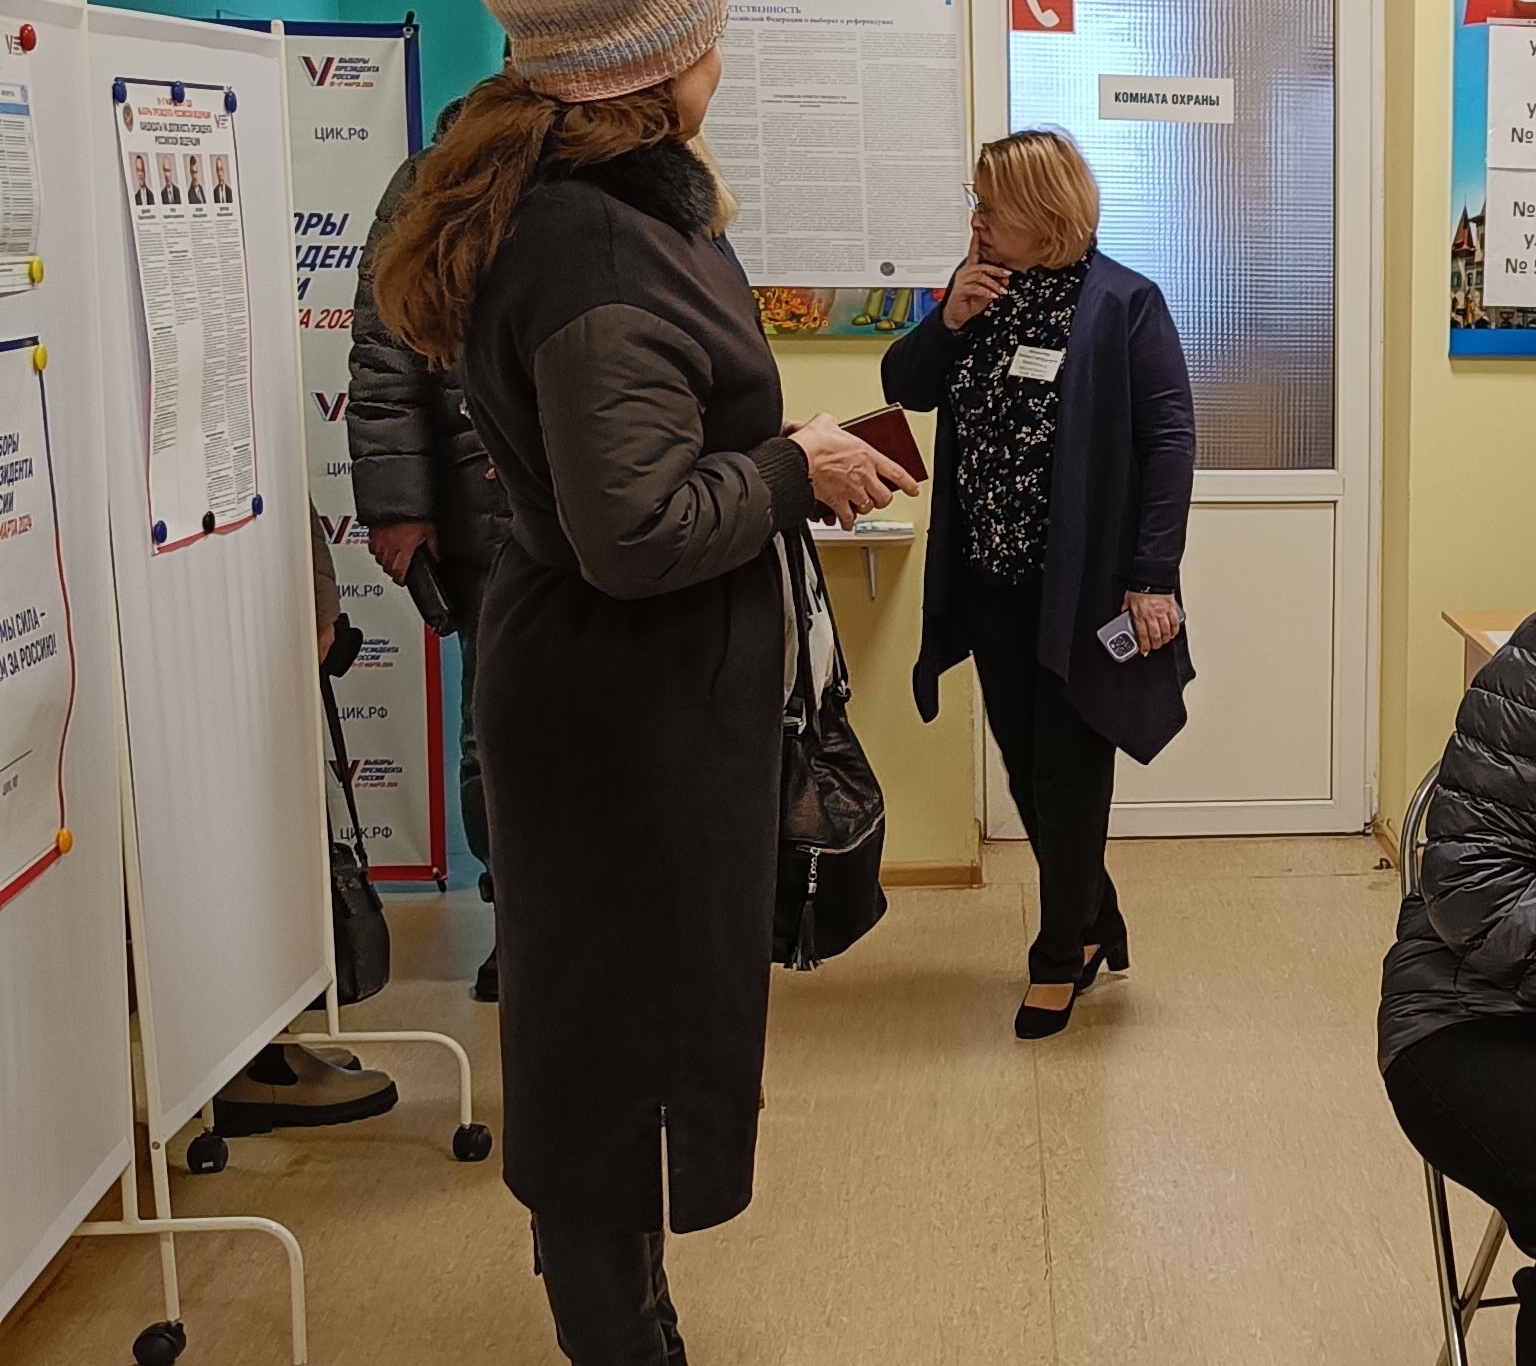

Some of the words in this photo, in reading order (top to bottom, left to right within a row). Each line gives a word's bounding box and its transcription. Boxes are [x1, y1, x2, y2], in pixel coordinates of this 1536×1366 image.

[1114, 91, 1168, 105] КОМНАТА
[1171, 93, 1219, 106] ОХРАНЫ
[314, 127, 368, 141] ЦИК.РФ
[1512, 128, 1533, 143] №
[1513, 202, 1535, 217] №
[294, 213, 349, 236] ОРЫ
[1506, 258, 1527, 273] №
[315, 309, 355, 329] 202
[0, 457, 33, 487] ЗИДЕНТА
